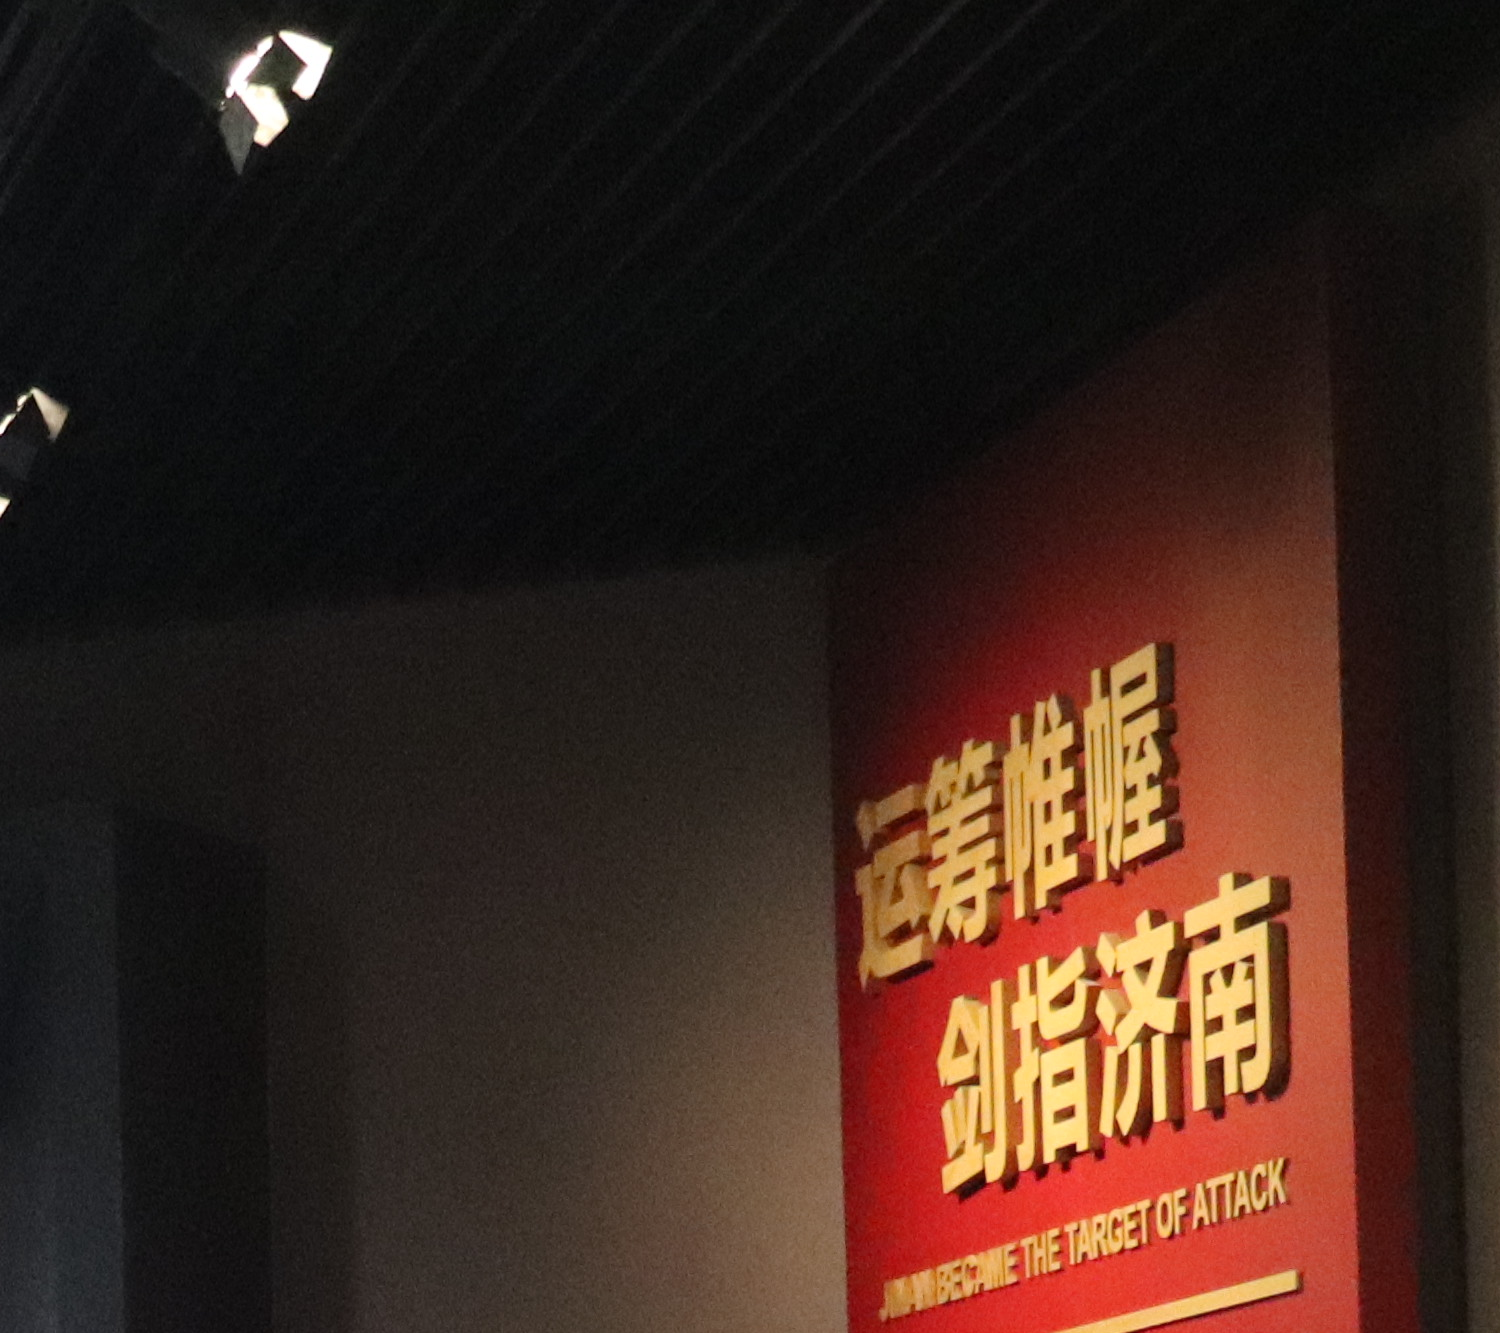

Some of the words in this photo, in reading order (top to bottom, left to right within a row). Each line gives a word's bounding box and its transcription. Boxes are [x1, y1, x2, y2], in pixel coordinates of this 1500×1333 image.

[854, 642, 1170, 979] 运筹帷幄
[936, 873, 1277, 1194] 剑指济南
[936, 1241, 1019, 1305] BECAME
[1020, 1227, 1061, 1280] THE
[1063, 1199, 1151, 1265] TARGET
[1155, 1187, 1187, 1240] OF
[1191, 1156, 1287, 1231] ATTACK
